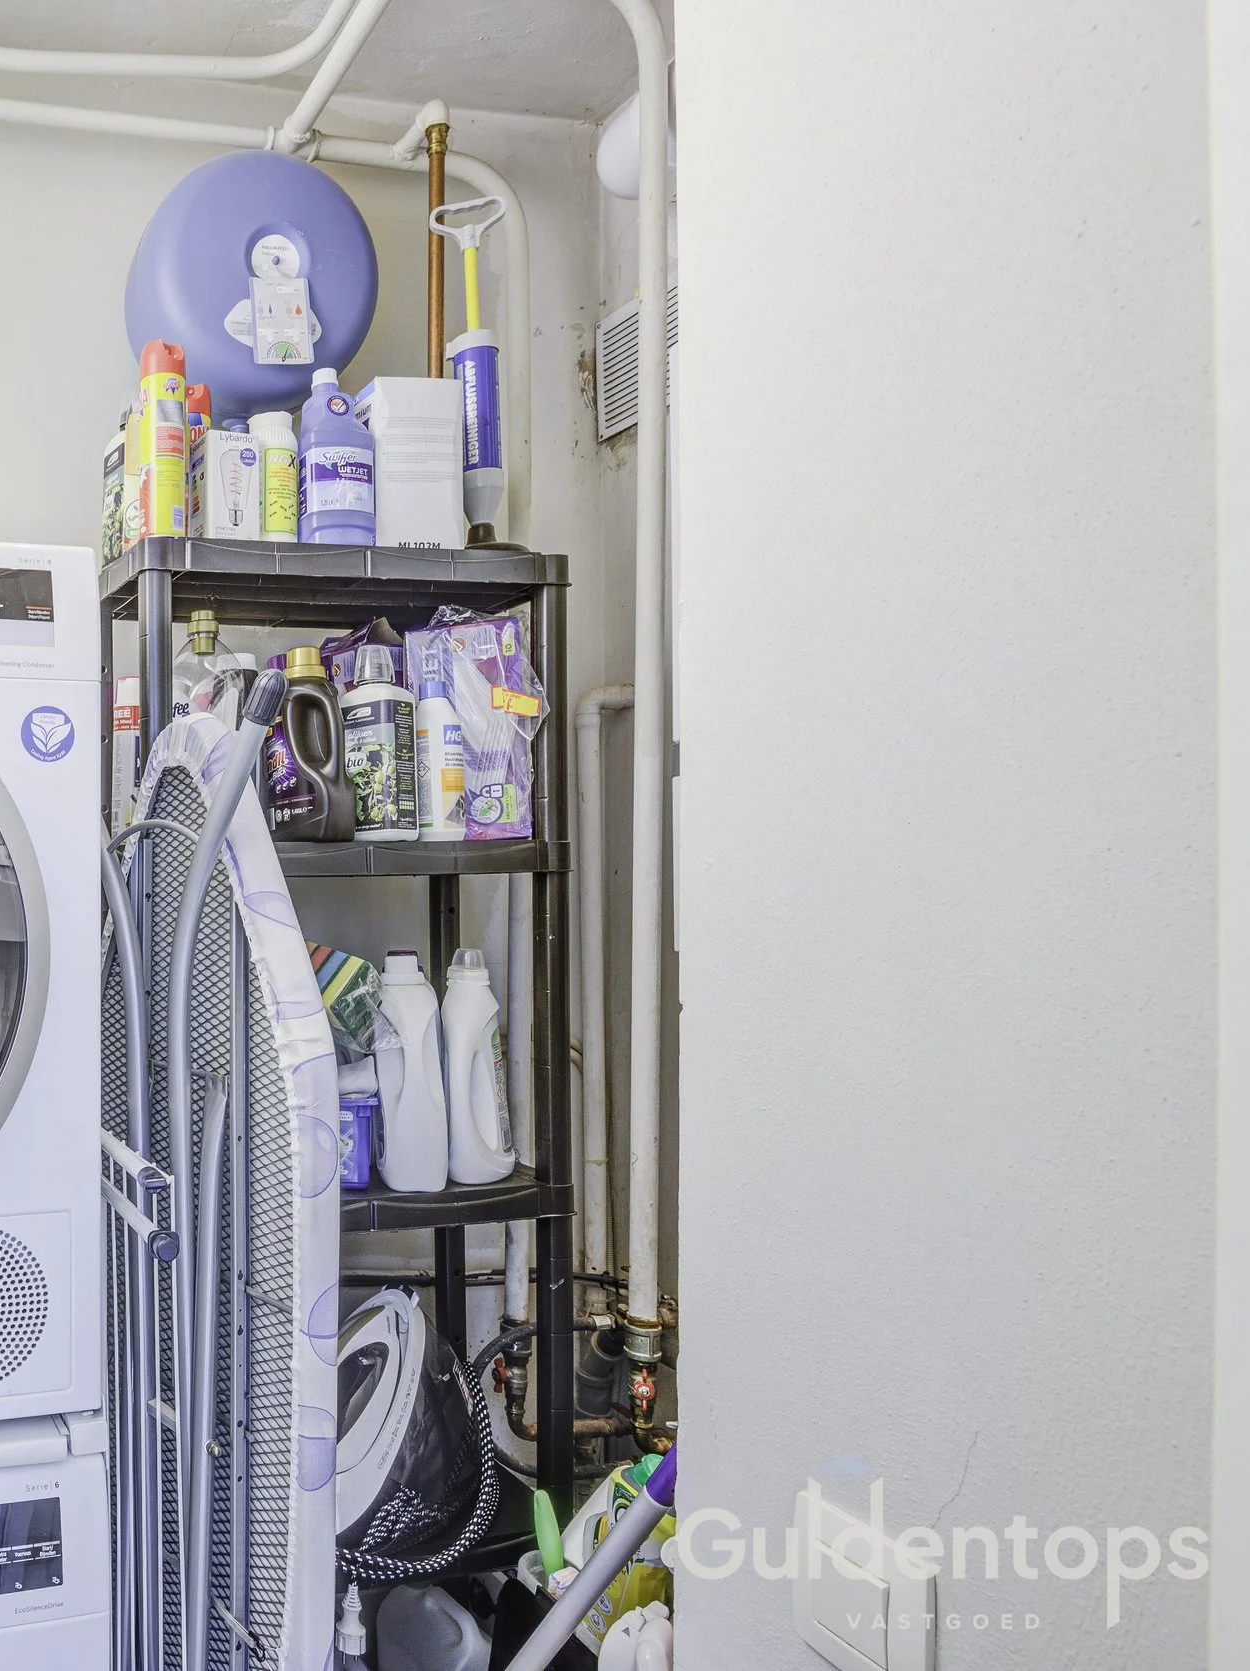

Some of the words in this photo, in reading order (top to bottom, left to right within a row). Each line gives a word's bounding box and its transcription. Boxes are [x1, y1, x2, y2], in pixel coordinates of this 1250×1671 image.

[464, 360, 479, 465] ABFLUSSREINIGER
[219, 432, 253, 444] Lybardo
[242, 450, 253, 458] 250
[319, 450, 358, 465] Swiffer
[338, 466, 368, 475] WETJET
[18, 557, 41, 565] Serie
[505, 643, 512, 653] 10
[22, 660, 55, 669] Condenser
[446, 730, 462, 742] HG
[347, 757, 364, 768] bio
[25, 1483, 49, 1492] Serie
[54, 1481, 60, 1489] 6
[14, 1602, 64, 1614] EcoSilenceDrive
